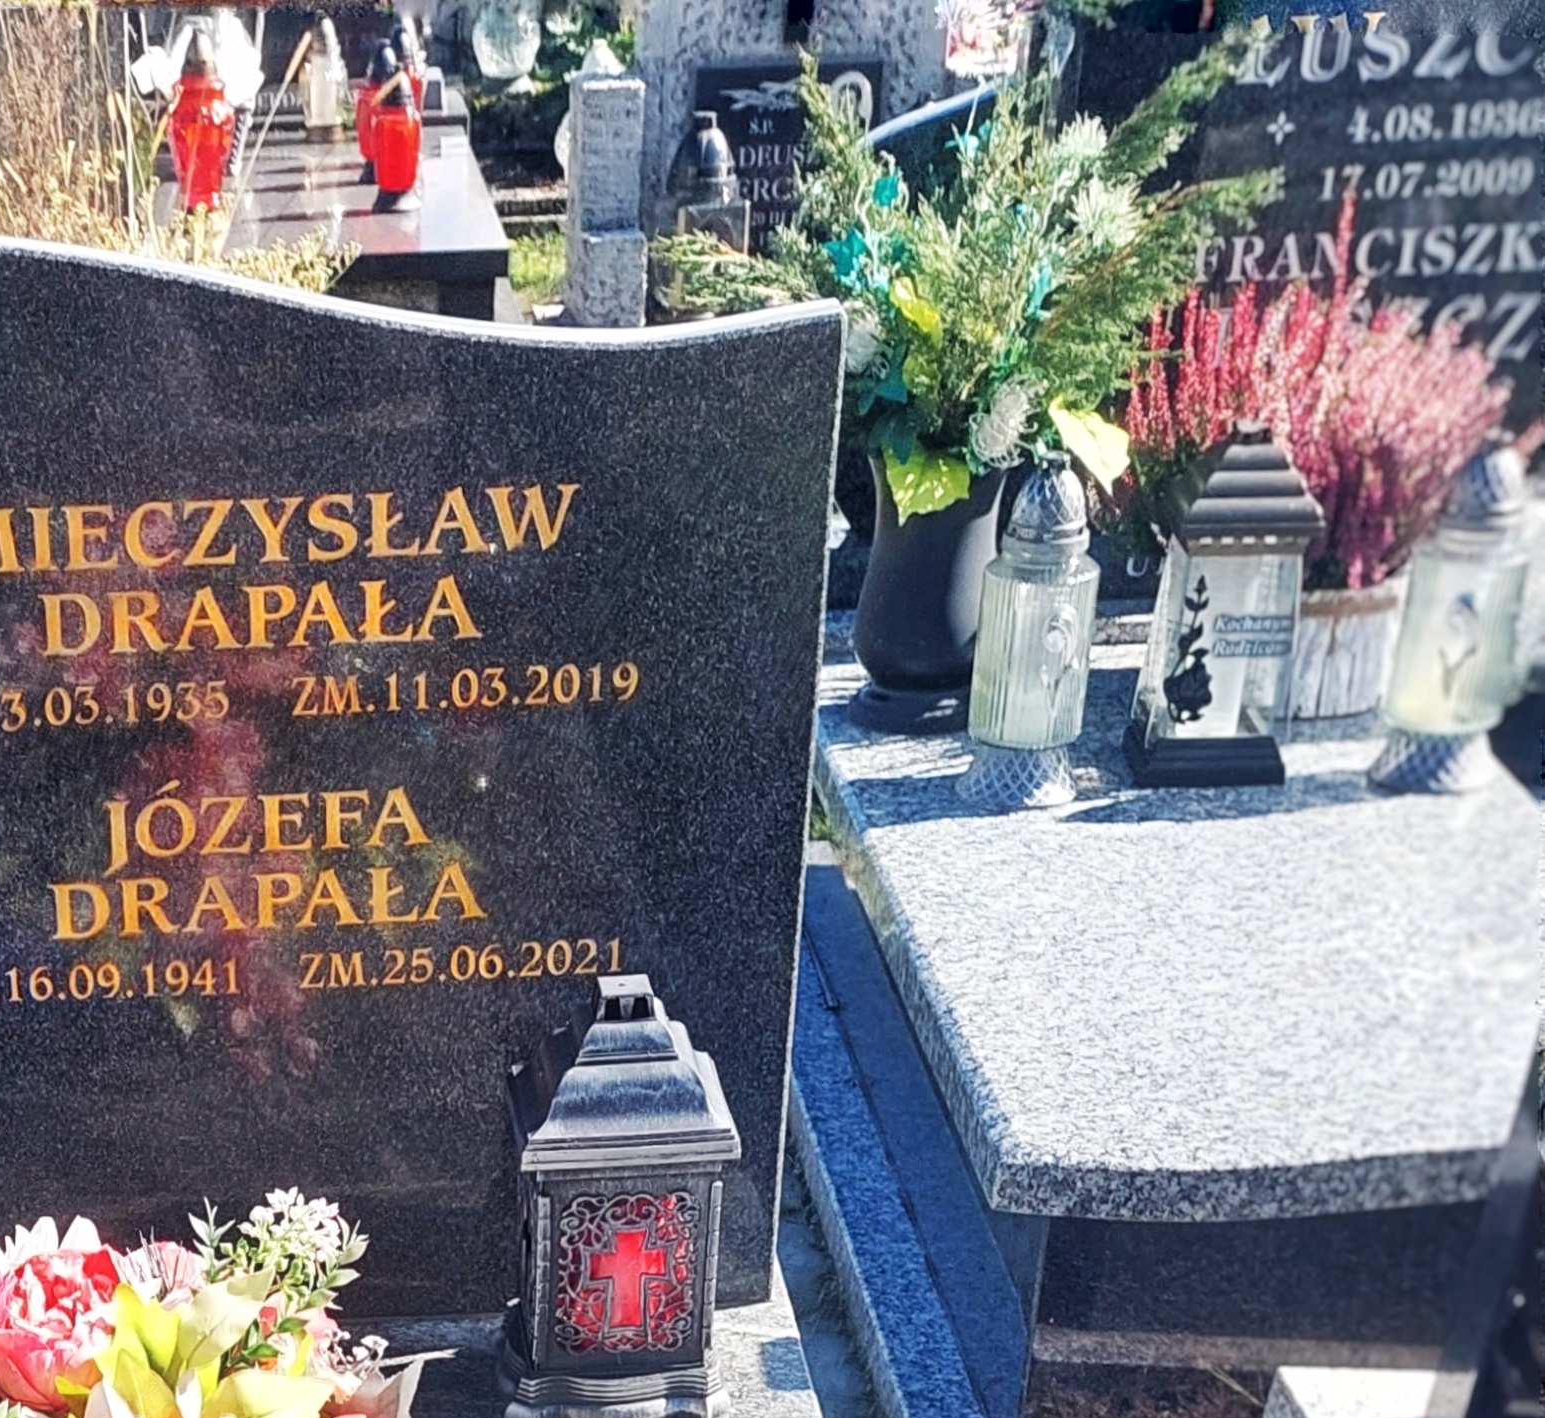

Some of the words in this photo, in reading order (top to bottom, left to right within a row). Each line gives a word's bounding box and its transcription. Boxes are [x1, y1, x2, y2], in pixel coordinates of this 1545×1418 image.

[37, 575, 483, 657] DRAPAŁA
[291, 661, 641, 718] ZM.11.03.2019
[103, 779, 433, 876] JÓZEFA
[47, 861, 488, 941] DRAPAŁA
[299, 937, 624, 990] ZM.25.06.2021
